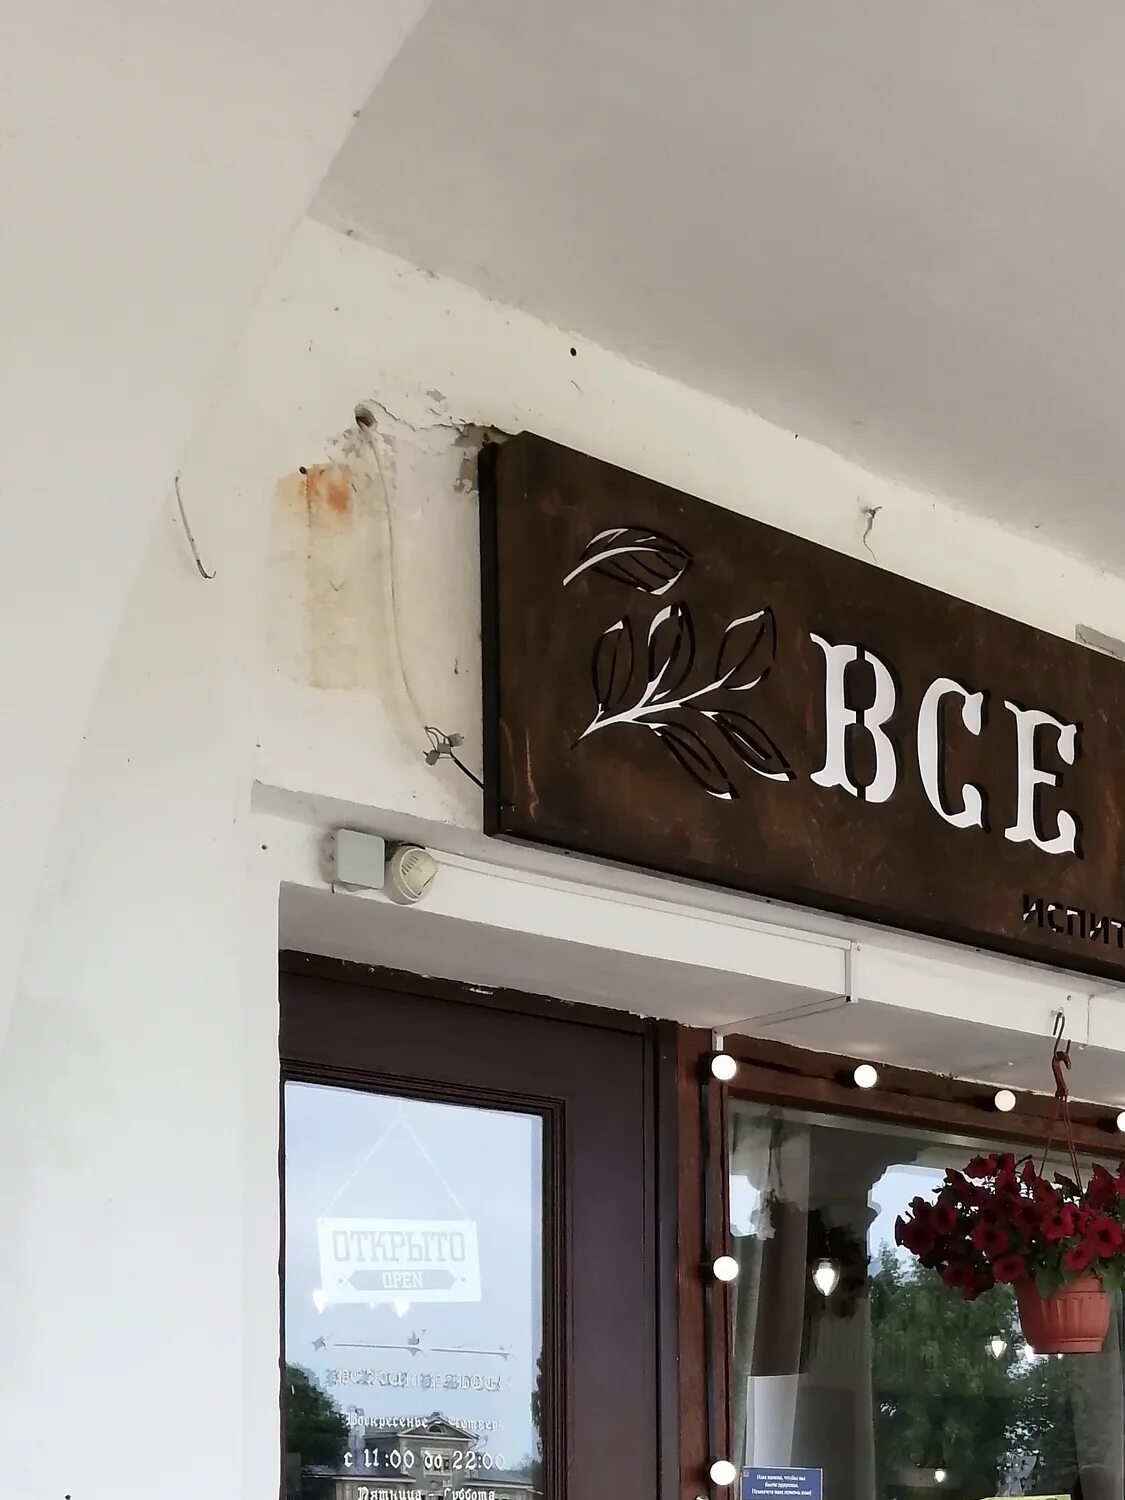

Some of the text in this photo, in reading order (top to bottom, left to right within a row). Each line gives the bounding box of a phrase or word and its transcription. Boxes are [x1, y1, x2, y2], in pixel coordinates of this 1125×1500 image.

[808, 632, 1082, 857] ВСЕ
[332, 1230, 466, 1262] ОТКРЫТО
[382, 1271, 424, 1289] OPEN
[344, 1411, 429, 1429] Воскресенье
[424, 1450, 443, 1469] до
[452, 1449, 506, 1470] 22:00
